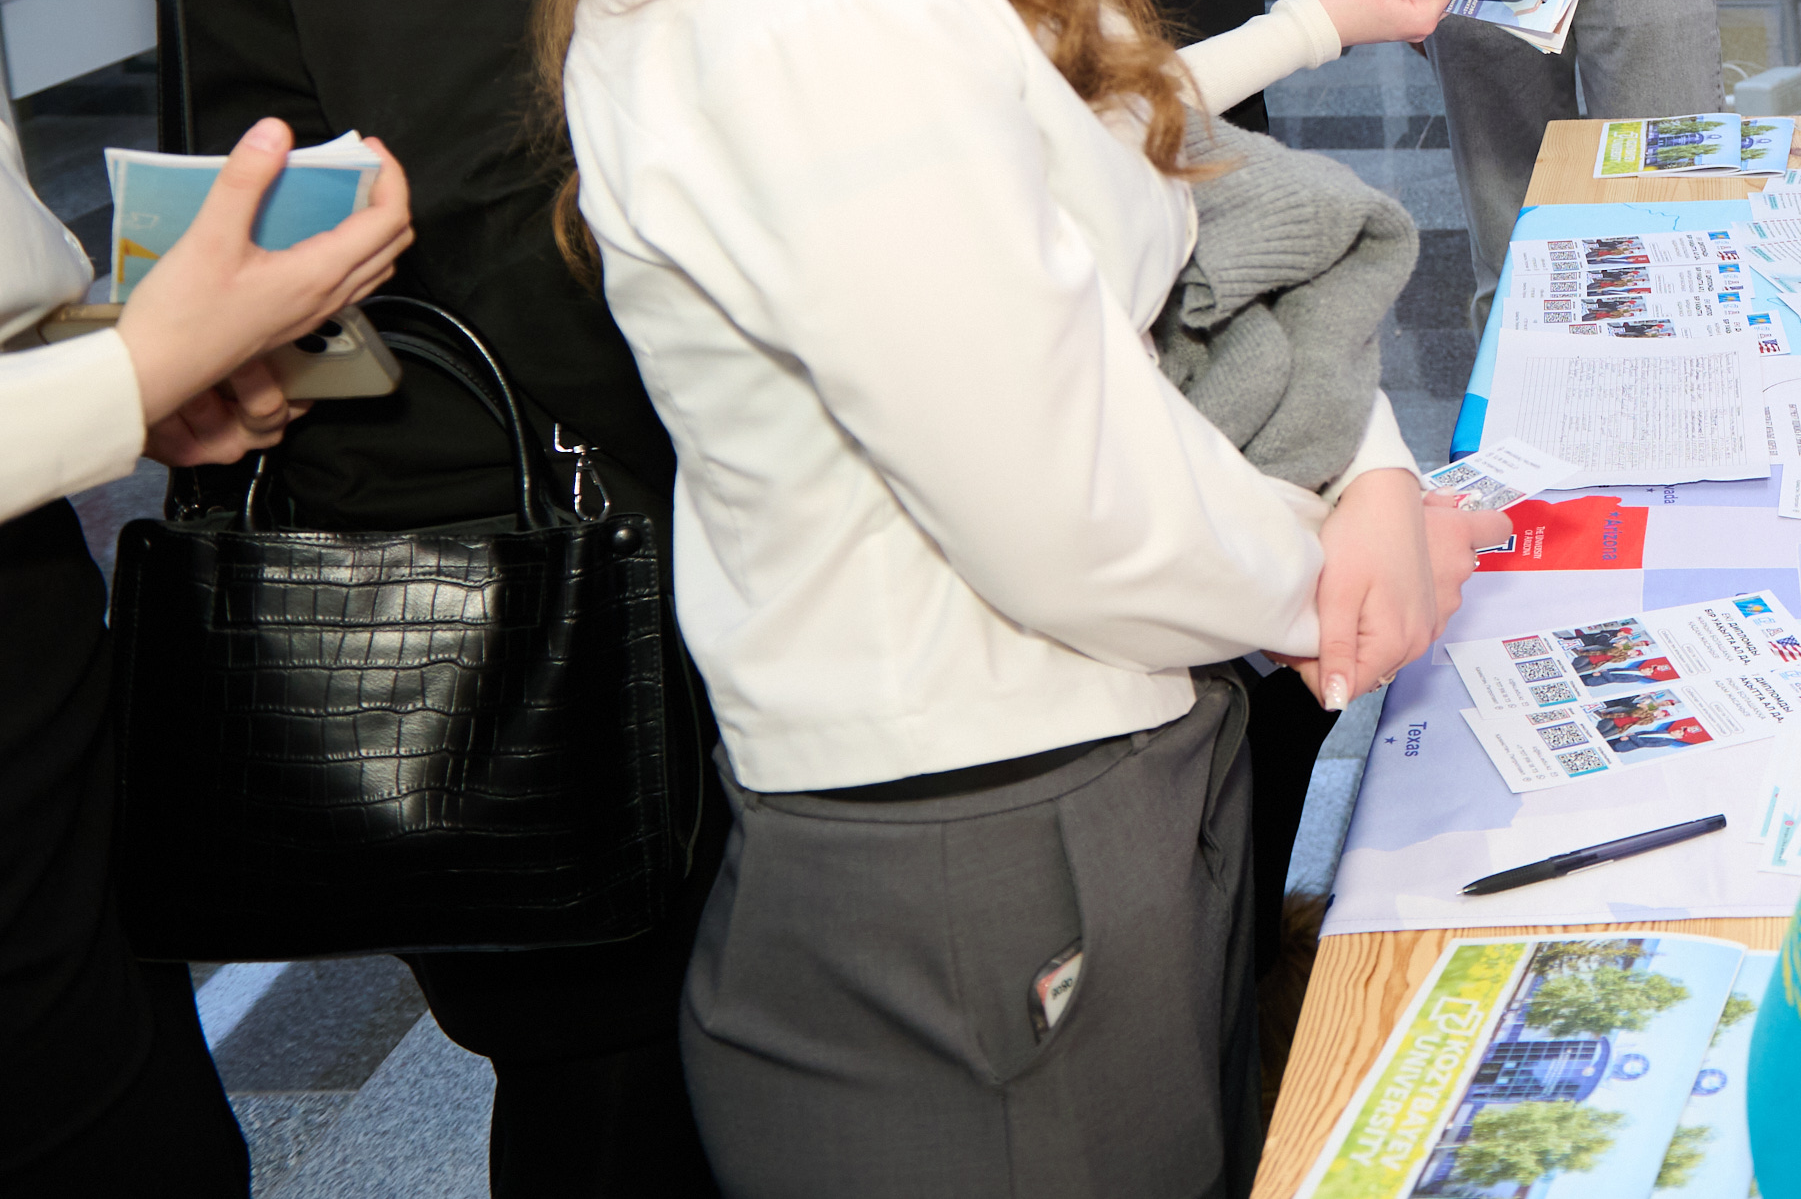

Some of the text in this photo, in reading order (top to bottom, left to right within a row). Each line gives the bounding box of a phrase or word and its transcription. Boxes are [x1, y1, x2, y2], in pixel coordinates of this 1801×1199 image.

[1602, 519, 1623, 561] Arizona
[1704, 608, 1716, 618] БІР
[1727, 622, 1760, 657] ДИПЛОМДЫ
[1405, 721, 1427, 757] Texas
[1350, 1036, 1441, 1167] UNIVERSITY
[1380, 1039, 1470, 1170] KOZYBAYEV
